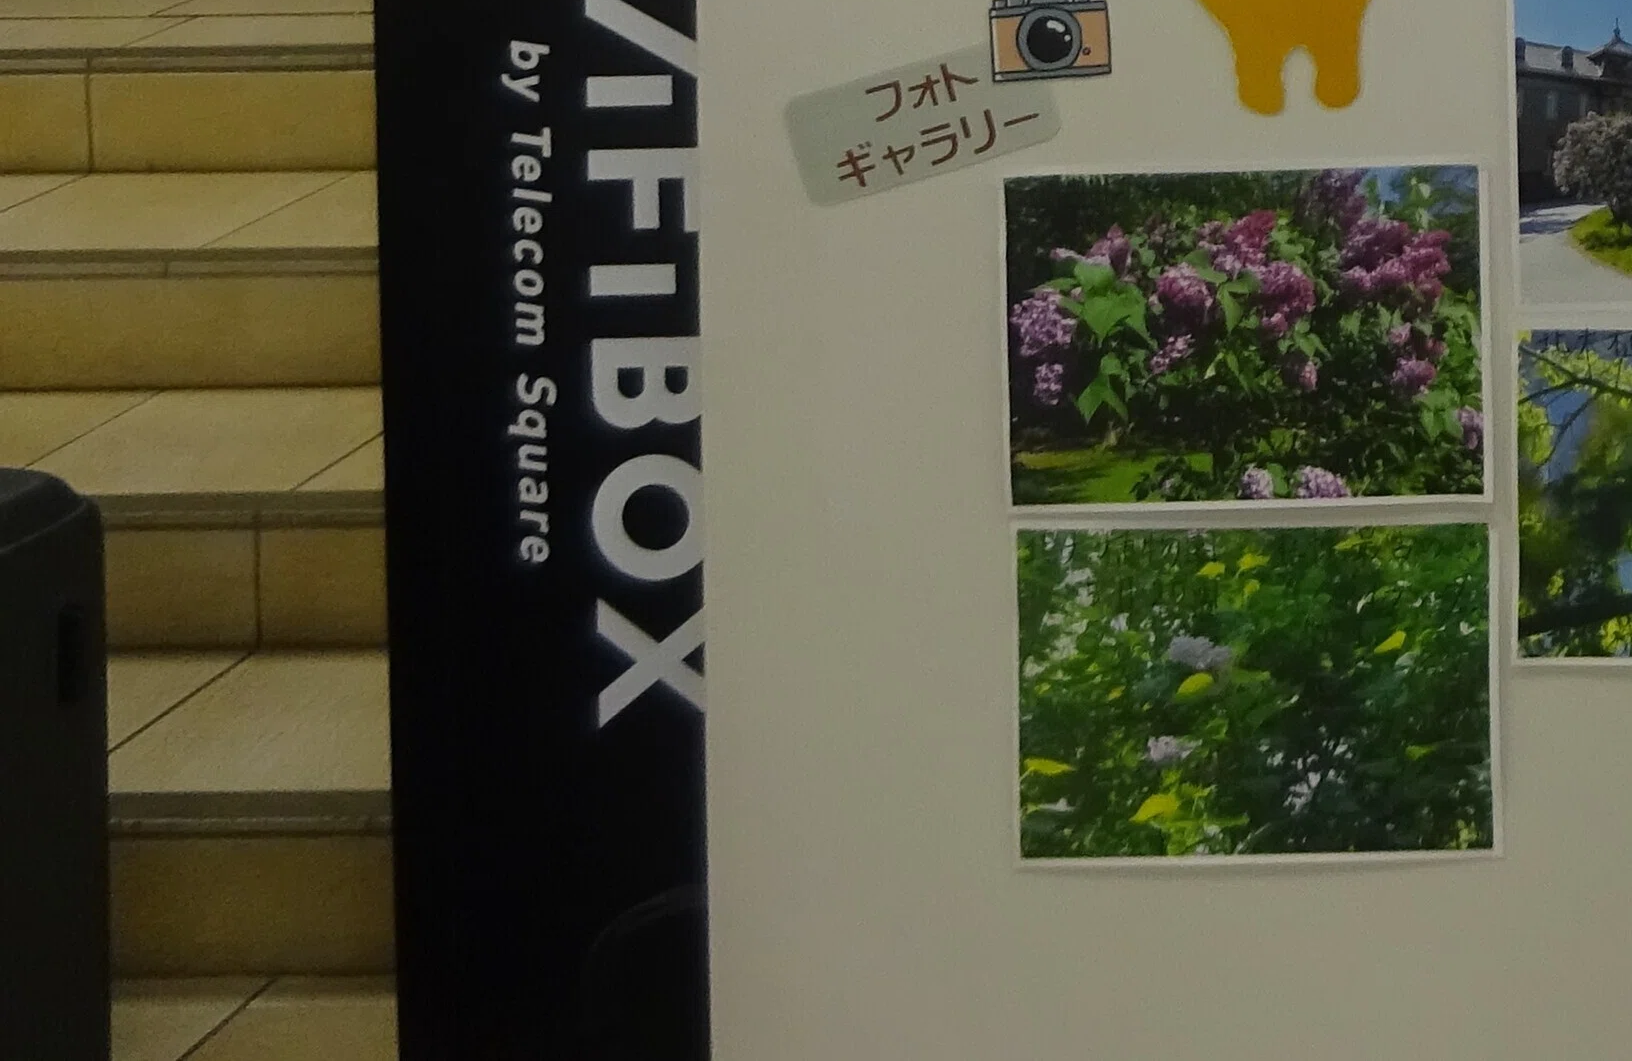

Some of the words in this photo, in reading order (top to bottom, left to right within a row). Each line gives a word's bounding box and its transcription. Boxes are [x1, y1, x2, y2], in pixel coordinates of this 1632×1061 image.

[503, 38, 550, 104] by
[865, 63, 979, 122] フォト
[836, 109, 1040, 188] ギャラリー
[508, 128, 553, 346] Telecom
[508, 374, 558, 565] Square
